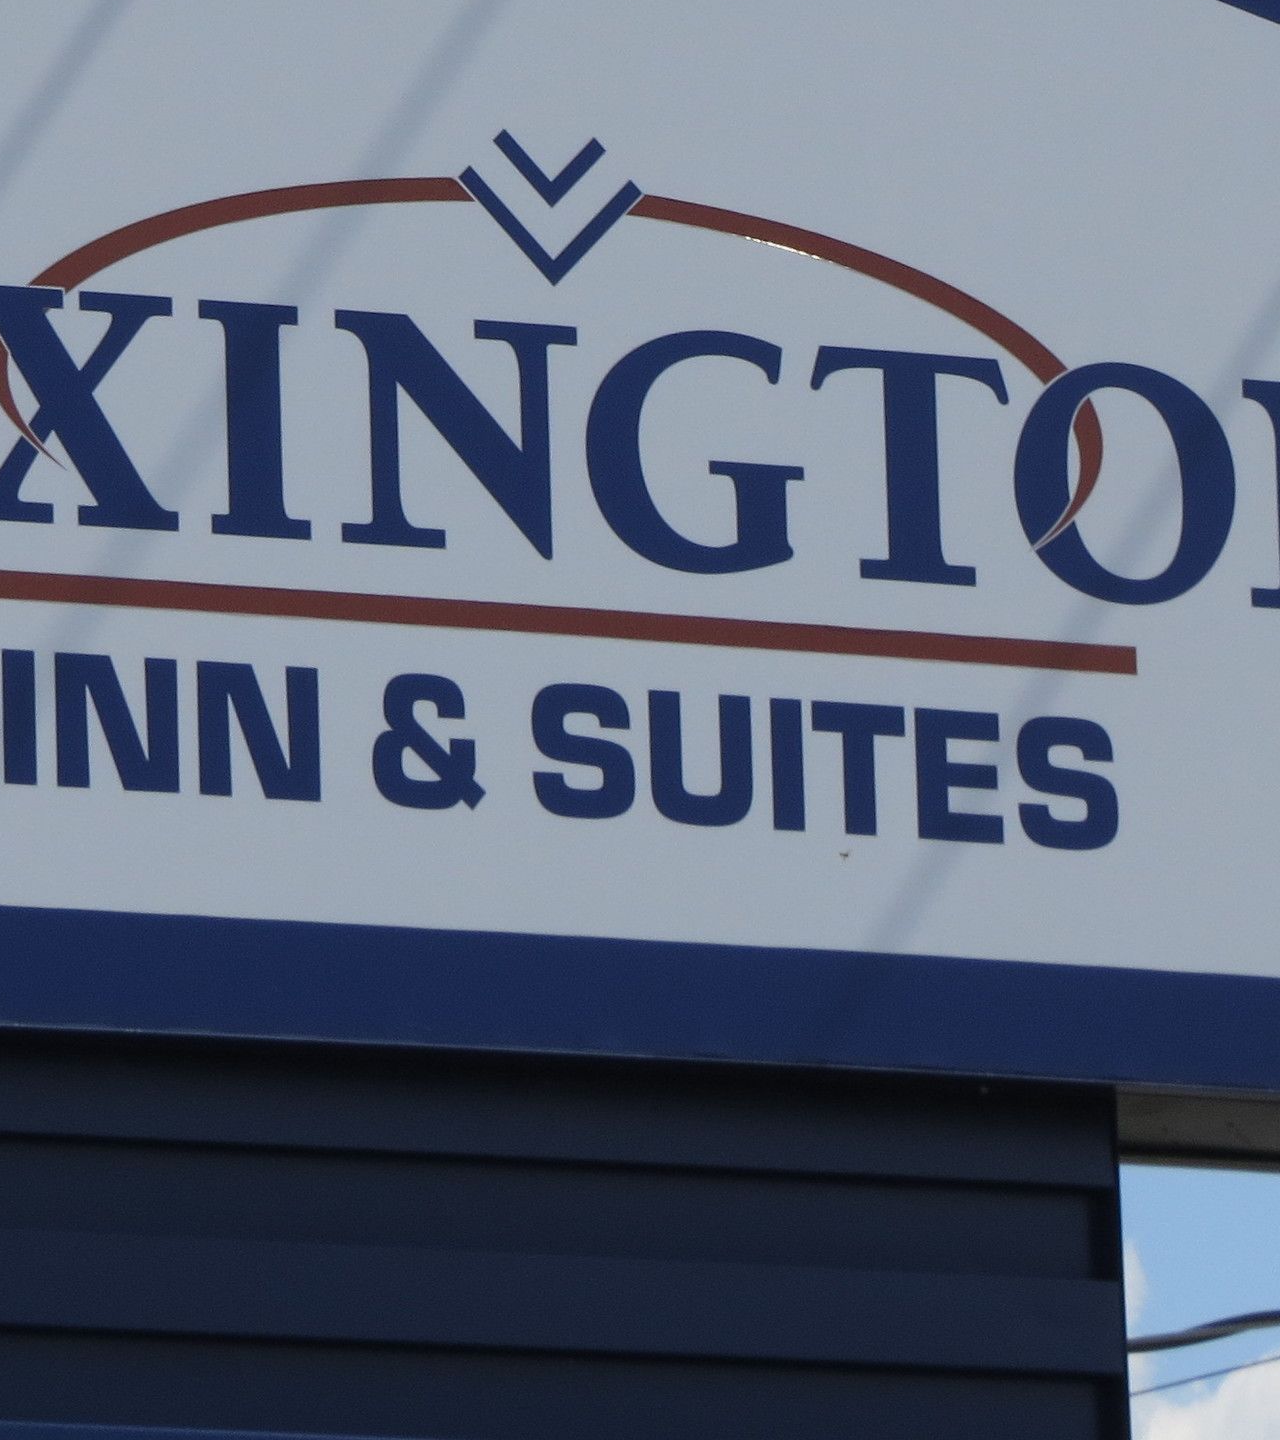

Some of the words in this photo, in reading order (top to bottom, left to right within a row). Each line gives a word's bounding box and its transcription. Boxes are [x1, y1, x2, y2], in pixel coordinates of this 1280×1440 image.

[1, 649, 321, 802] INN
[372, 673, 486, 810] &
[531, 683, 1119, 851] SUITES
